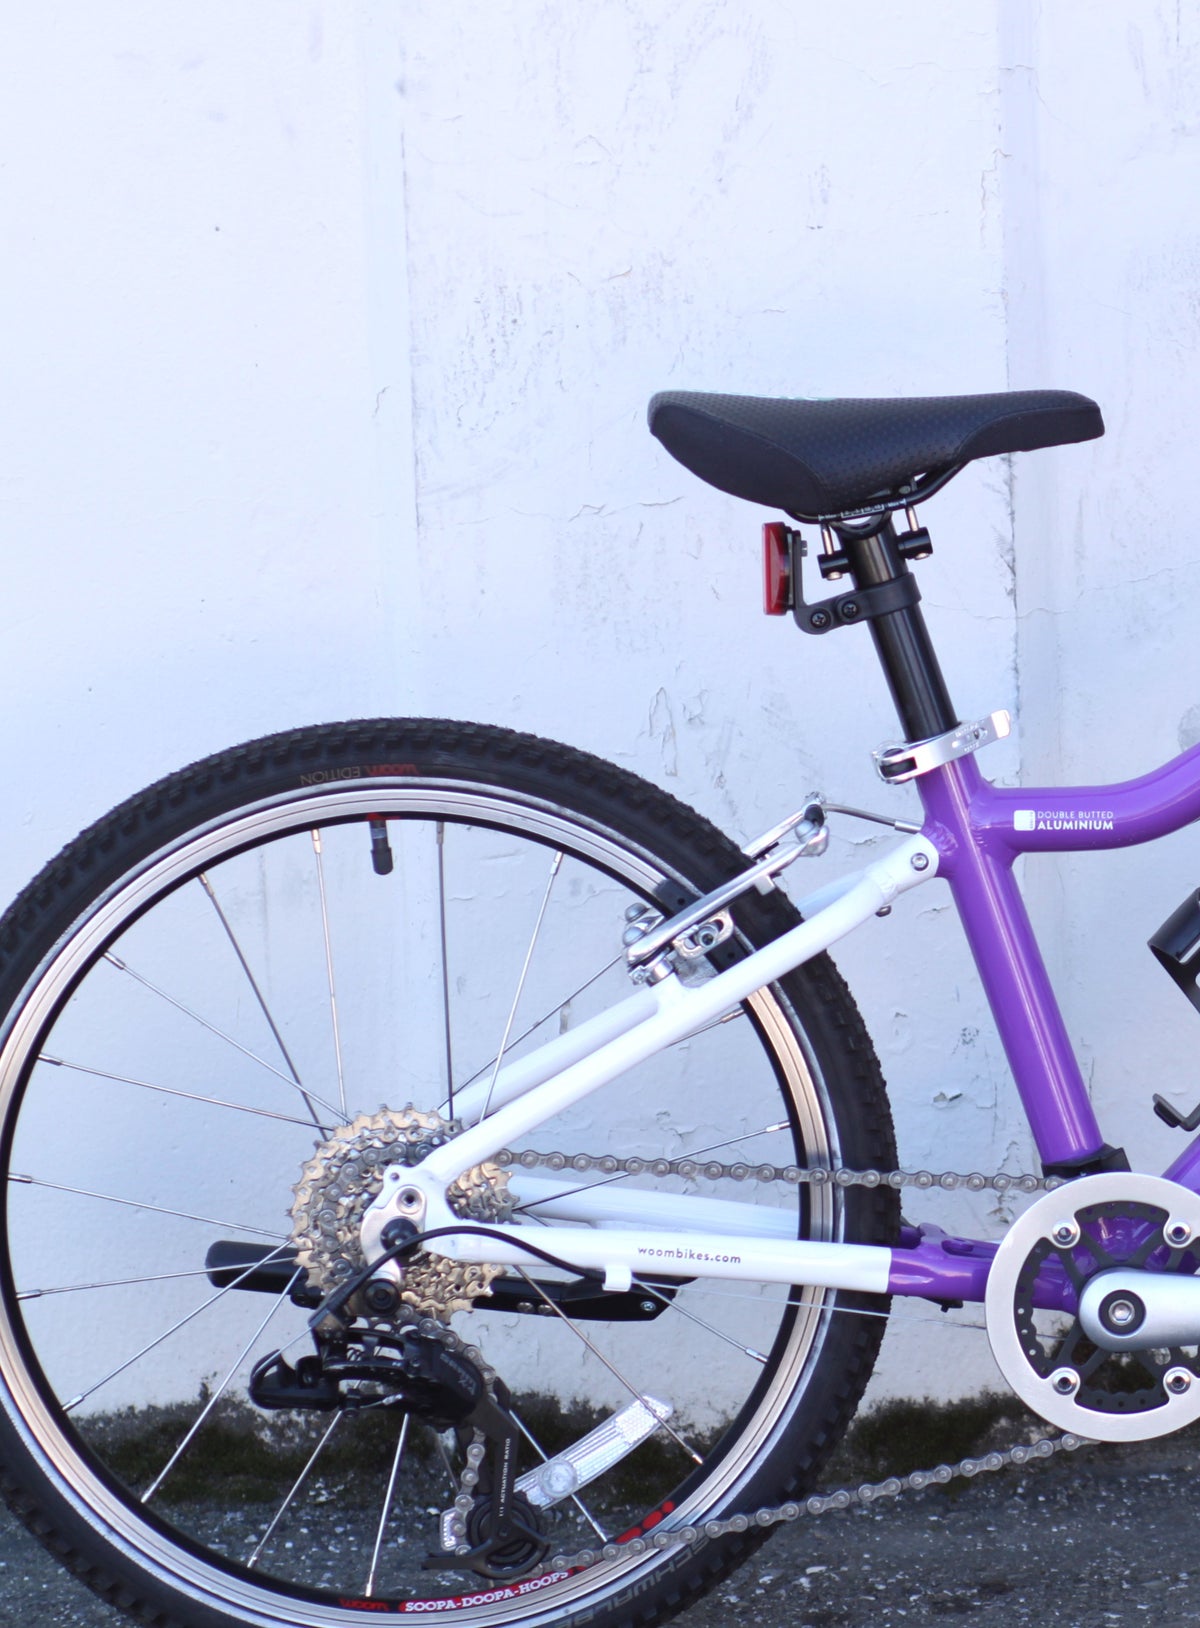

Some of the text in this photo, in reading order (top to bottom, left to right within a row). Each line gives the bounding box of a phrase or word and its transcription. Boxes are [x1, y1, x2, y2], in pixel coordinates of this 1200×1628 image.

[300, 766, 361, 786] EDITION
[1037, 810, 1114, 820] DOUBLE BUTTED
[1037, 820, 1114, 830] ALUMINIUM
[637, 1247, 742, 1264] woombikes.com
[405, 1571, 569, 1612] SOOPA-DOOPA-HOOPS
